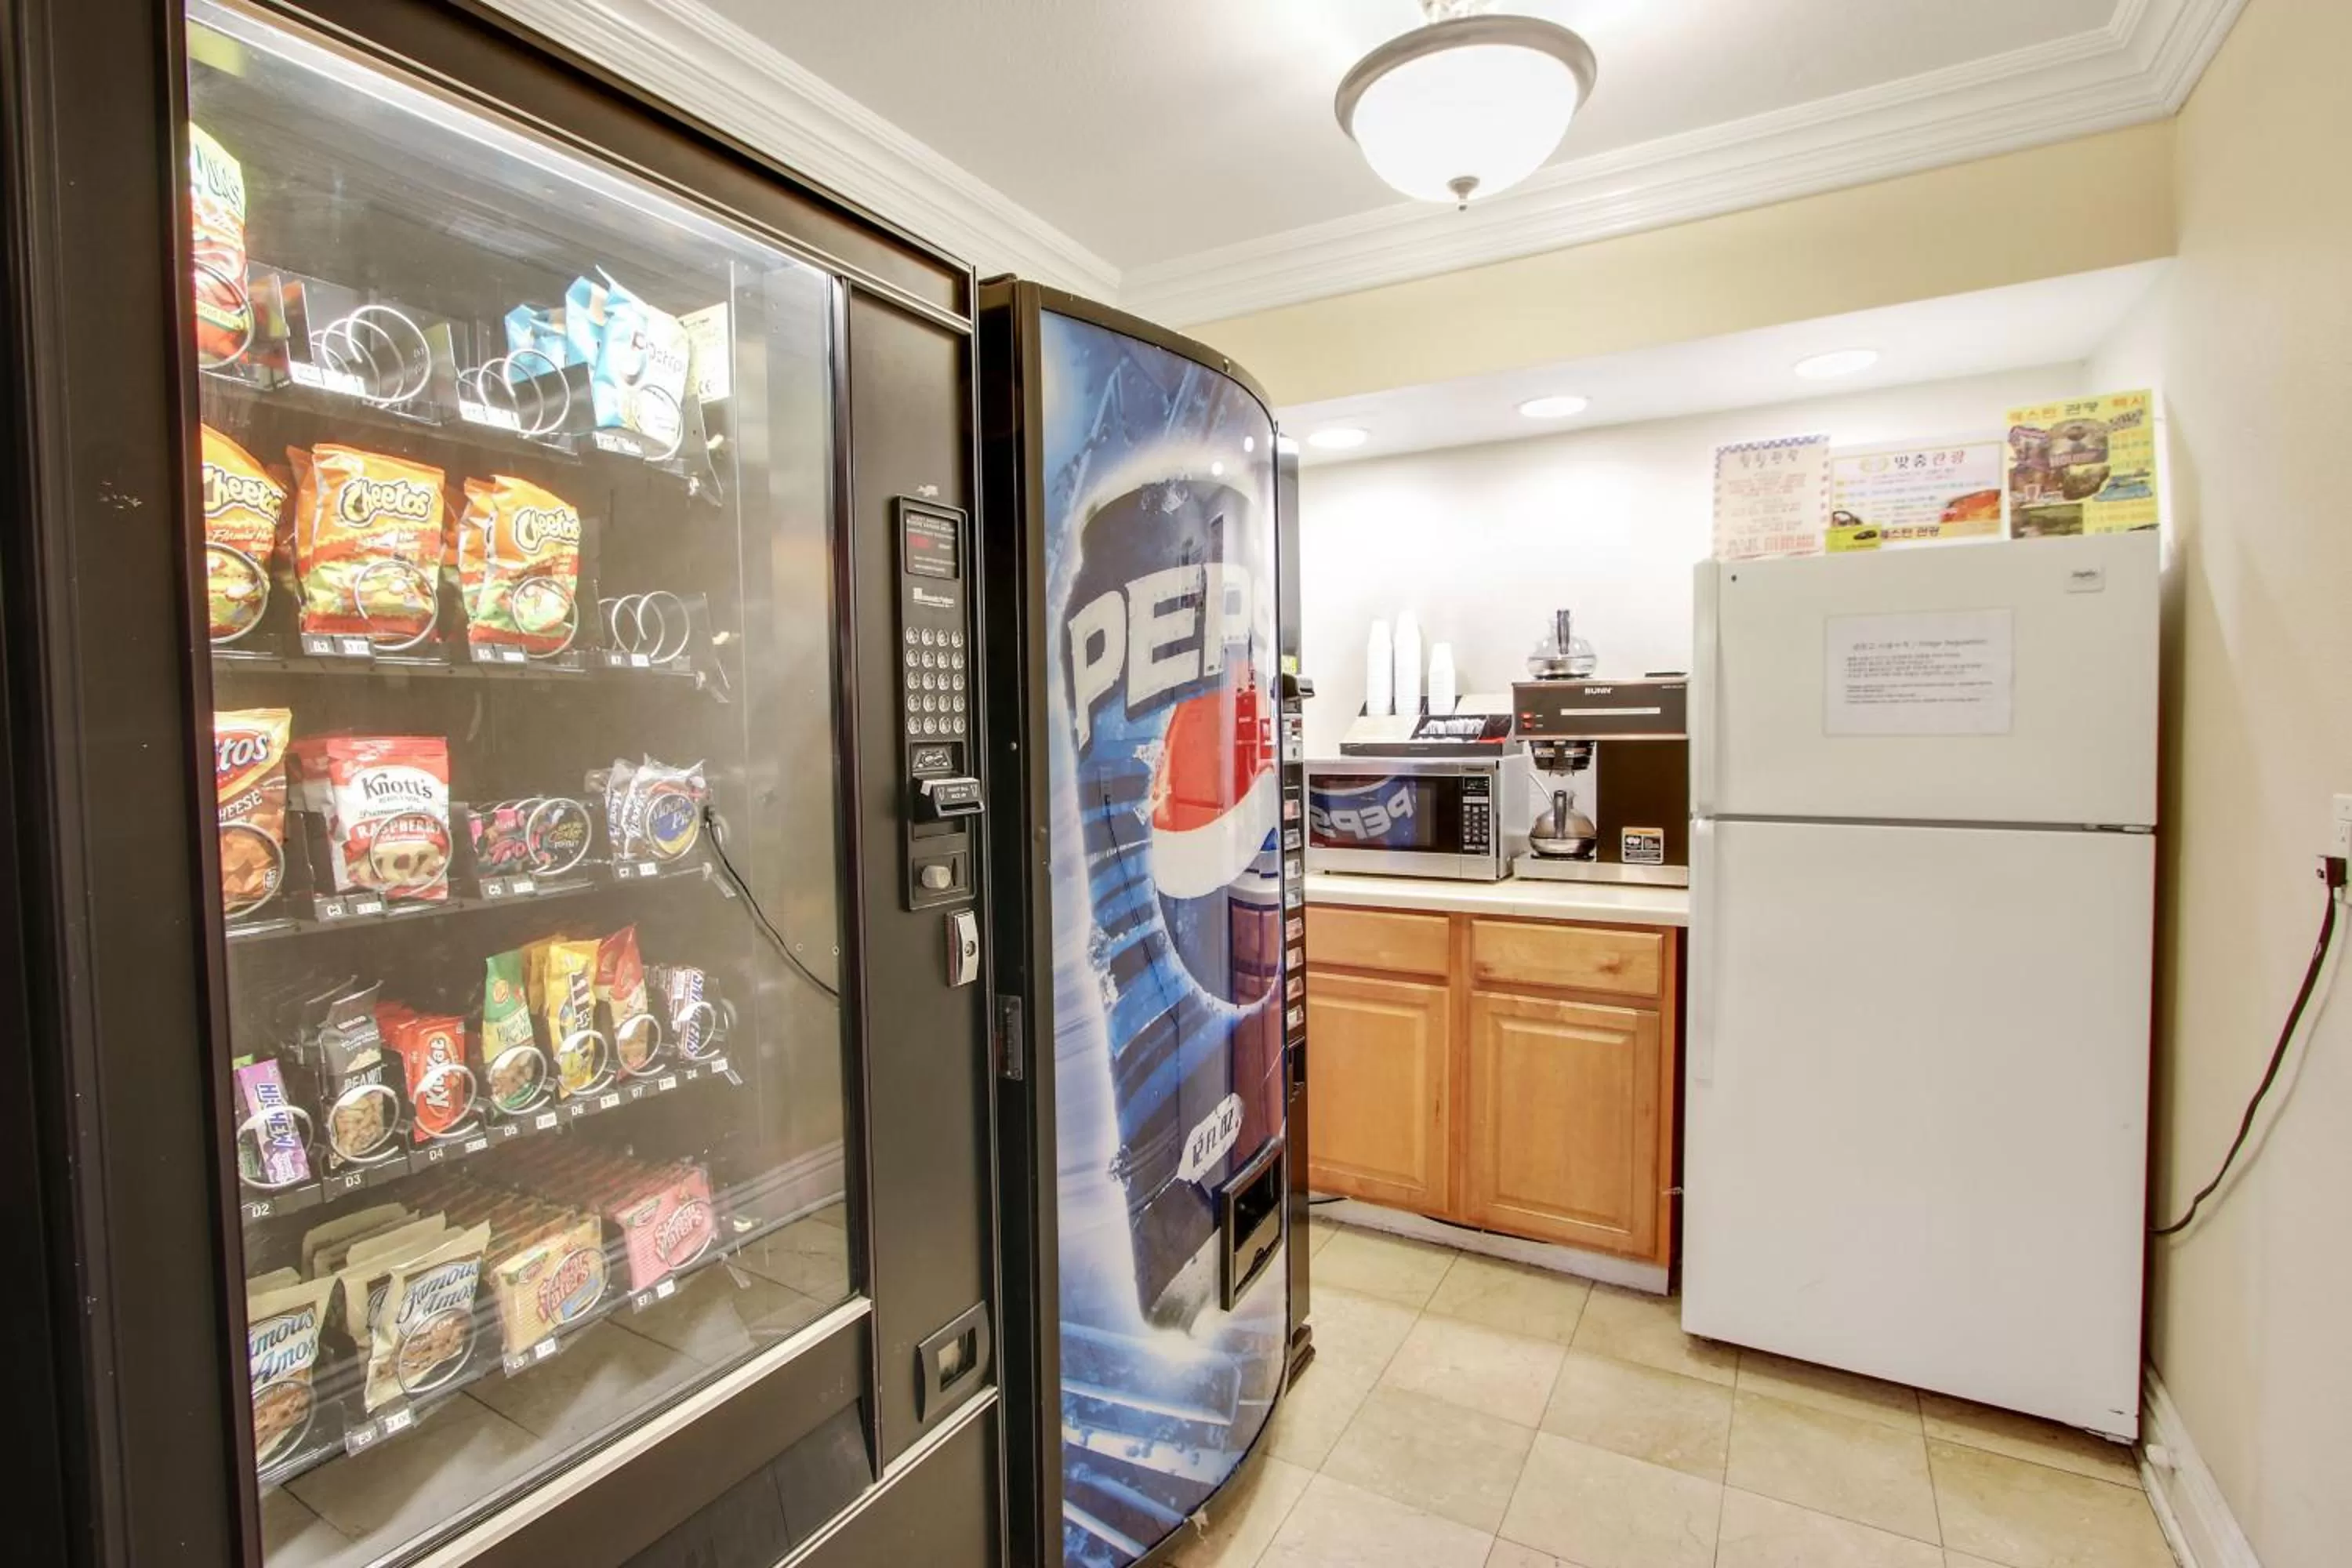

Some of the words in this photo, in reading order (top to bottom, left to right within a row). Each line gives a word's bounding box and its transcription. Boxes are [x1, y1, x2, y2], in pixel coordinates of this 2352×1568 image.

[341, 477, 432, 527] Cheetos
[514, 507, 580, 554] Cheetos
[215, 732, 269, 772] tos
[363, 773, 433, 800] Knott's
[429, 1148, 444, 1161] D4
[346, 1174, 361, 1188] D3
[251, 1203, 270, 1218] D2
[398, 1257, 481, 1324] Famous
[423, 1283, 477, 1317] Amos
[255, 1339, 316, 1384] Amos
